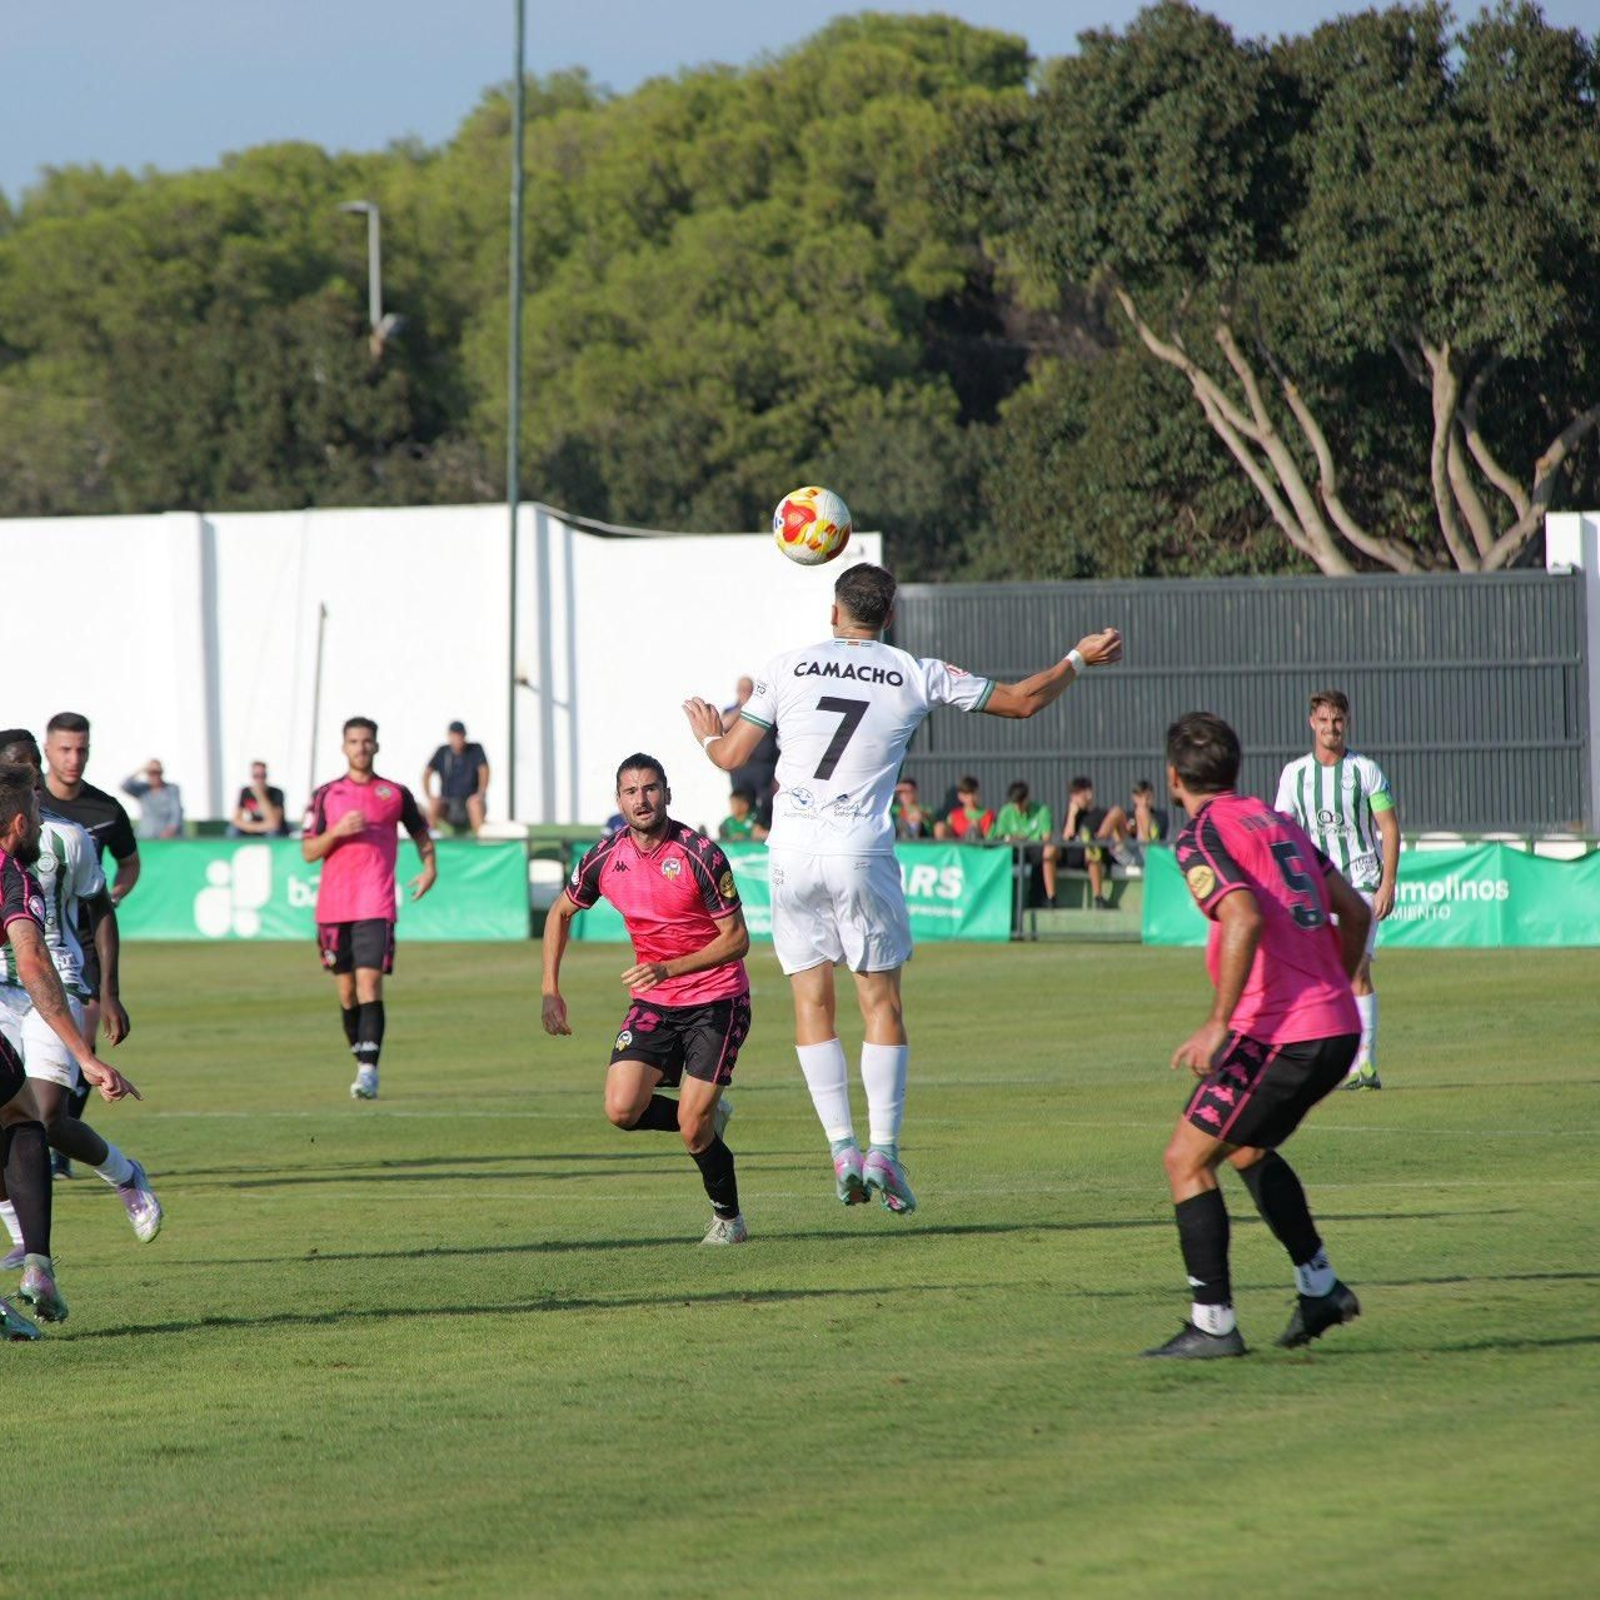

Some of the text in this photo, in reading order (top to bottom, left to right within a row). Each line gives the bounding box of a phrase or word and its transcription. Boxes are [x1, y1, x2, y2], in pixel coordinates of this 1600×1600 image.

[794, 661, 904, 687] CAMACHO
[813, 696, 871, 781] 7
[900, 864, 962, 900] RS
[1269, 841, 1325, 930] 5
[1387, 904, 1451, 921] MIENTO
